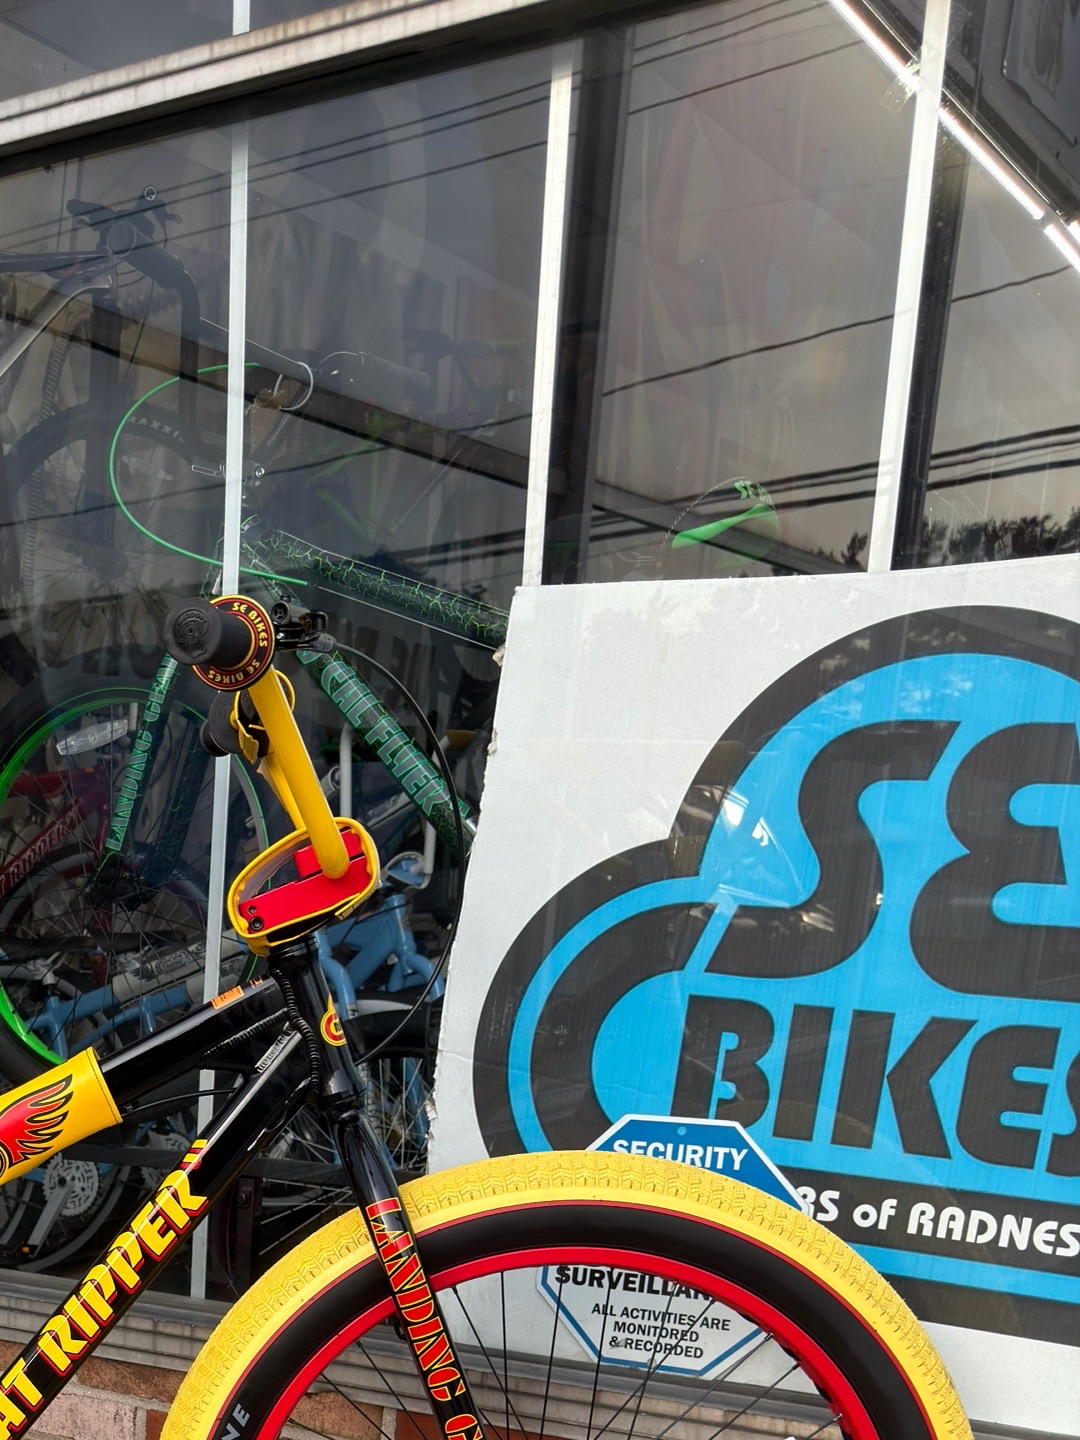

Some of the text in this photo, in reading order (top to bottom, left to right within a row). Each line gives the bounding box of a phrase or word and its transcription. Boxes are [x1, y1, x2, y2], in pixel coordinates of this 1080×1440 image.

[232, 602, 268, 647] SE BIKES
[207, 670, 245, 684] BIKES
[703, 718, 1080, 1003] SE
[852, 1198, 897, 1230] of
[366, 1197, 467, 1402] LANDING
[591, 1302, 731, 1332] ALL ACTIVITIES ARE
[613, 1320, 700, 1344] MONITORED
[623, 1337, 704, 1359] RECORDED
